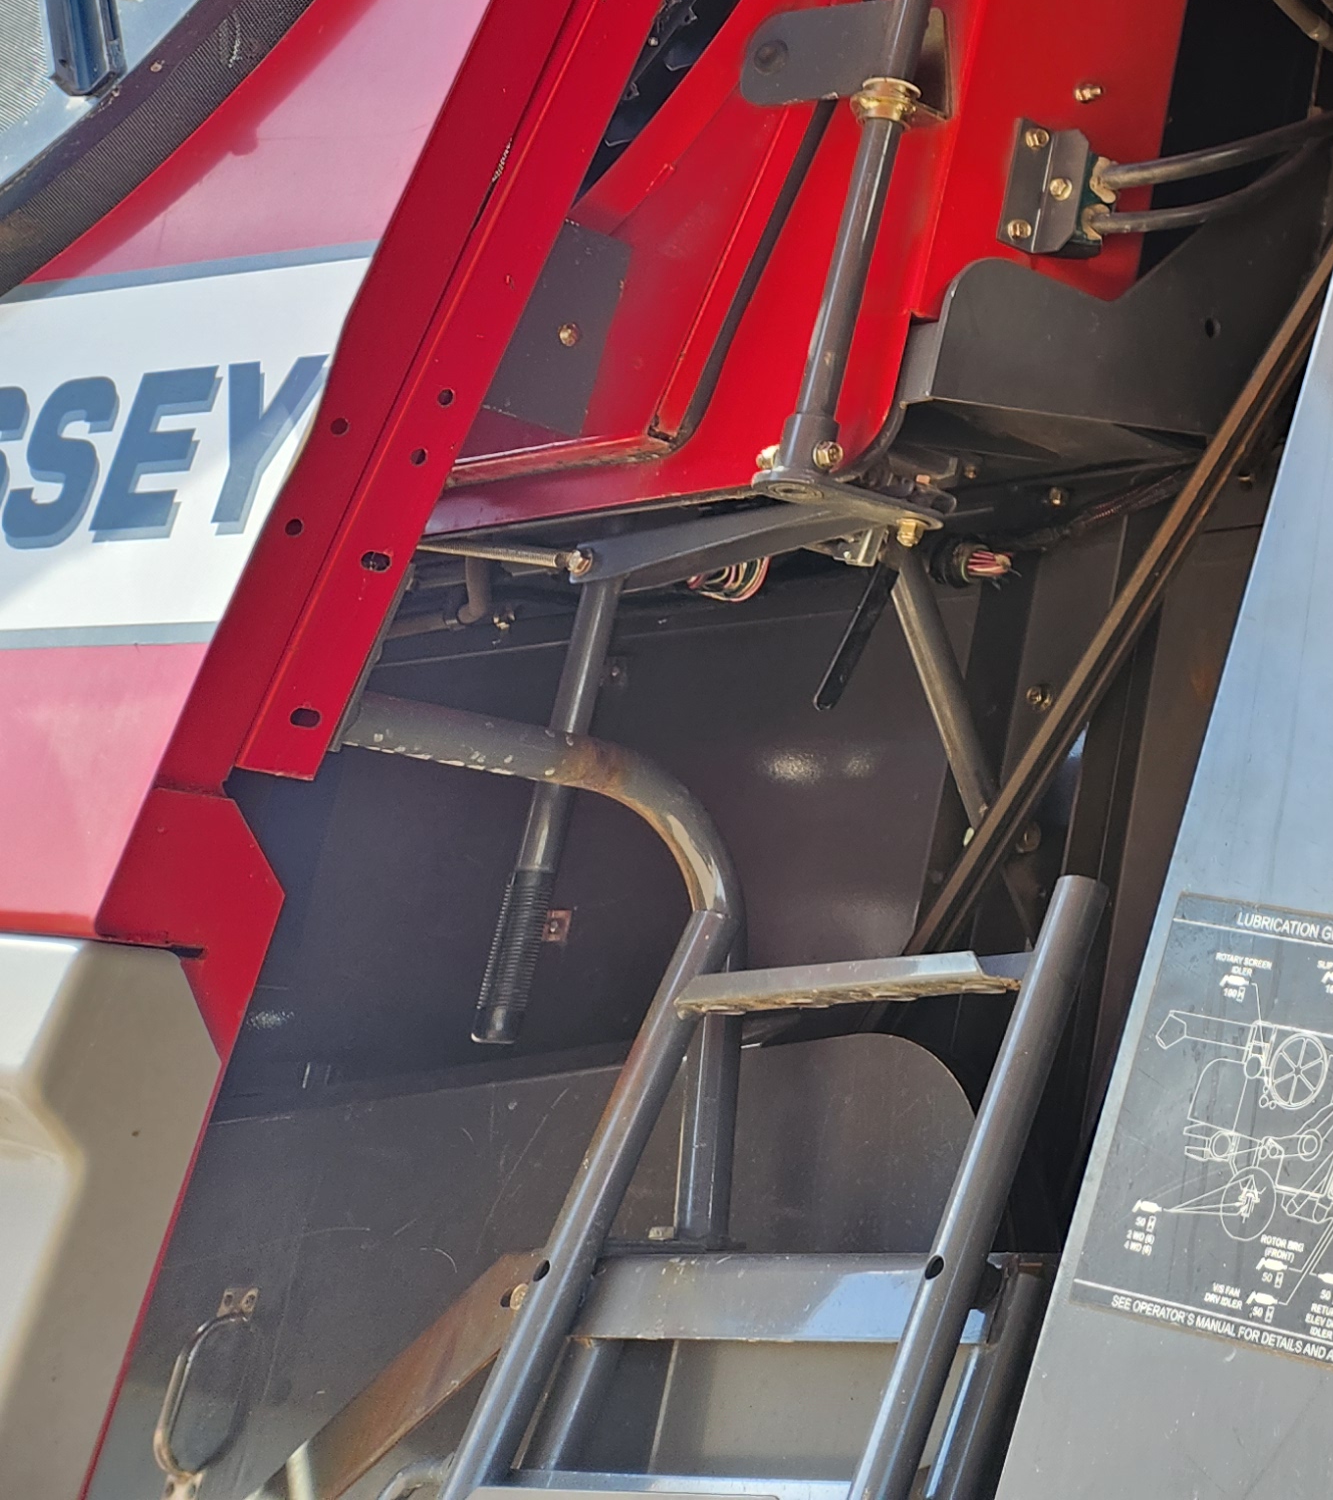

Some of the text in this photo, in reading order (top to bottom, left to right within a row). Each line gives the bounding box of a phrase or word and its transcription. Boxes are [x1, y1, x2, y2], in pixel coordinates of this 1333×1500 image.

[0, 354, 330, 549] SEY
[1236, 911, 1319, 939] LUBRICATION
[1216, 952, 1272, 970] ROTARY SCREEN
[1317, 960, 1333, 971] SLIP
[1231, 966, 1252, 977] IDLER
[1132, 1230, 1145, 1242] WD
[1260, 1234, 1287, 1249] ROTOR
[1130, 1243, 1142, 1253] WD
[1264, 1246, 1294, 1263] (FRONT)
[1262, 1272, 1273, 1283] 50
[1224, 1285, 1240, 1298] FAN
[1320, 1288, 1332, 1301] 50
[1204, 1292, 1242, 1310] DRV IDLER
[1252, 1306, 1263, 1318] 50
[1111, 1294, 1130, 1309] SEE
[1132, 1300, 1196, 1326] OPERATOR'S
[1196, 1316, 1236, 1338] MANUAL
[1238, 1326, 1260, 1343] FOR
[1261, 1331, 1302, 1354] DETAILS
[1302, 1343, 1328, 1359] AND
[1305, 1312, 1326, 1327] ELEV
[1310, 1326, 1333, 1340] IDLER
